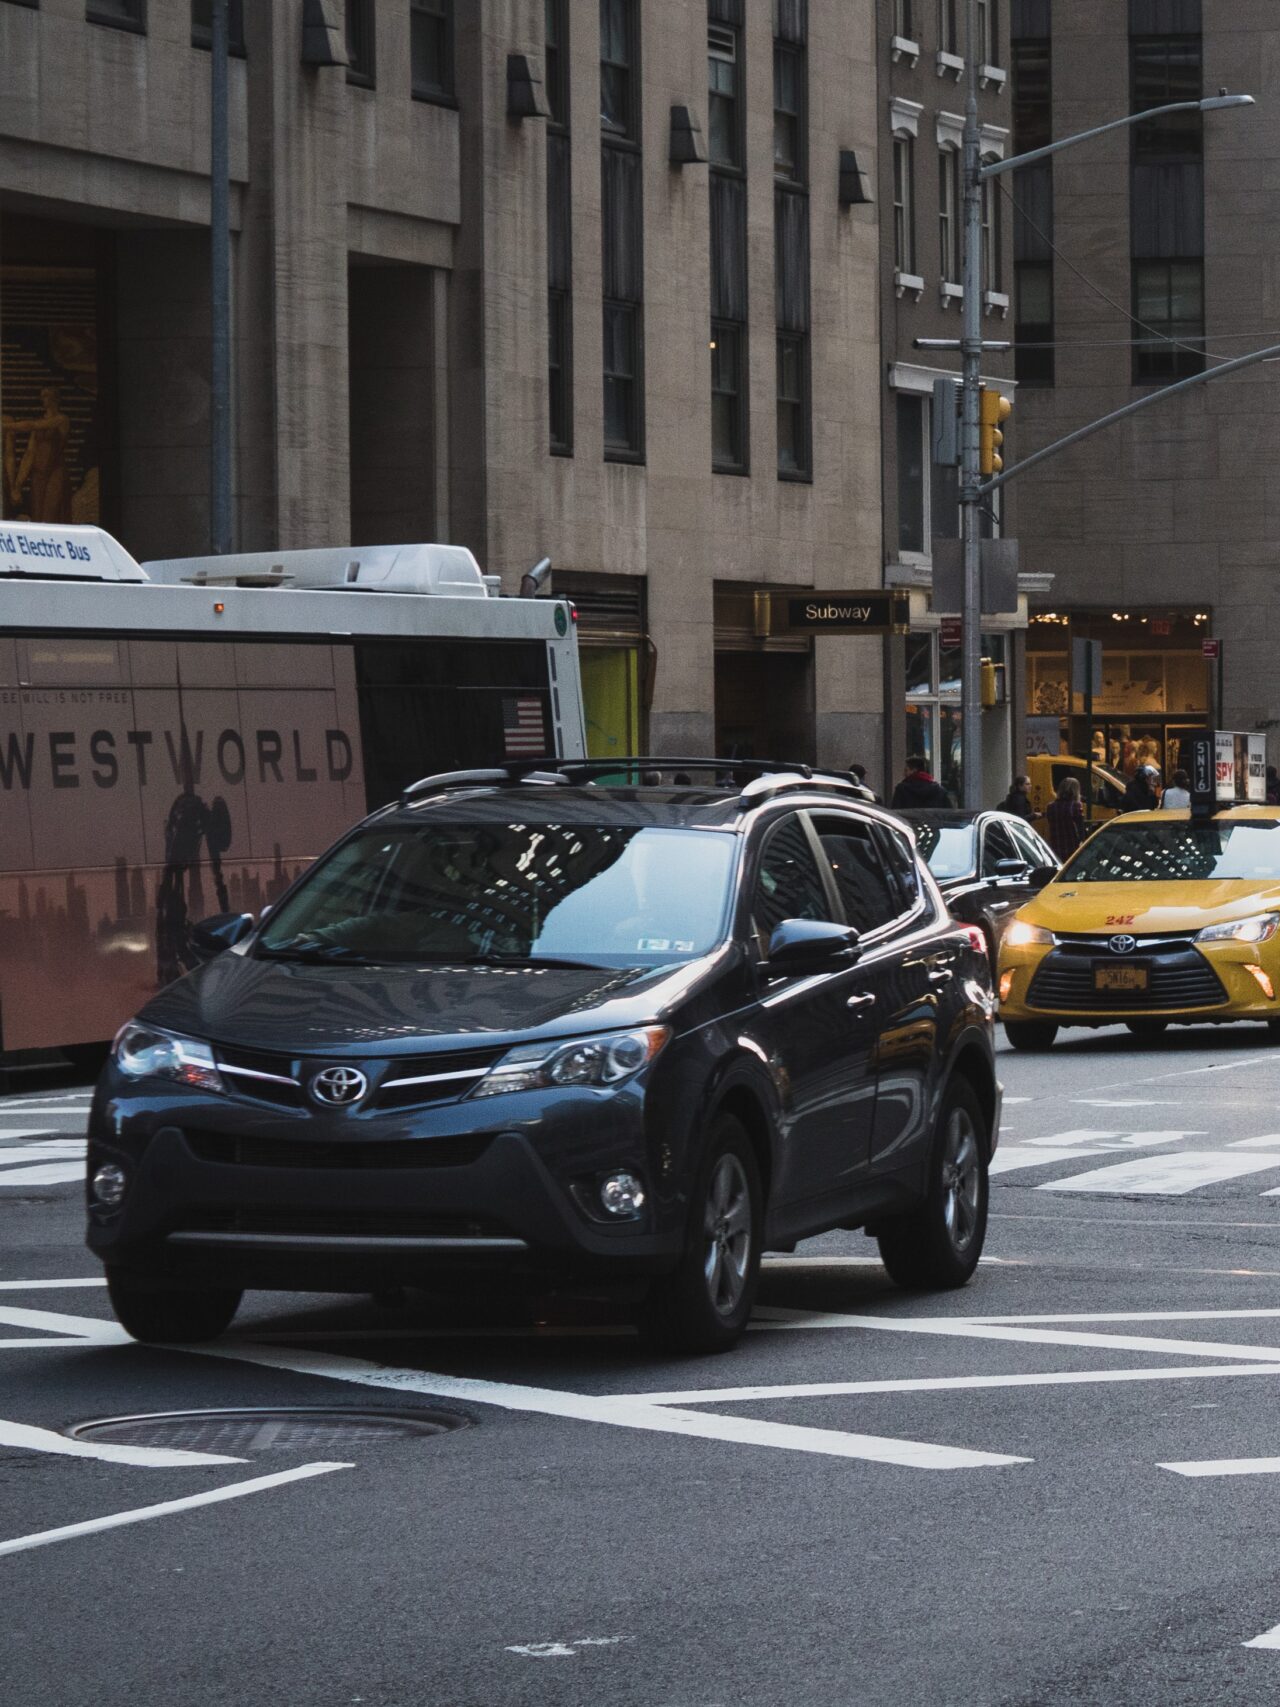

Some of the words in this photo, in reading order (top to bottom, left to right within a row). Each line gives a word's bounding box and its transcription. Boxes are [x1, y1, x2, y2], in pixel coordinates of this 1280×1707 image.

[16, 535, 66, 559] Electric
[65, 540, 91, 561] Bus
[805, 603, 871, 621] Subway
[55, 693, 66, 703] IS
[71, 693, 93, 703] NOT
[99, 693, 128, 703] FREE
[0, 728, 353, 791] WESTWORLD
[1216, 762, 1233, 781] SPY
[1105, 915, 1135, 925] 242
